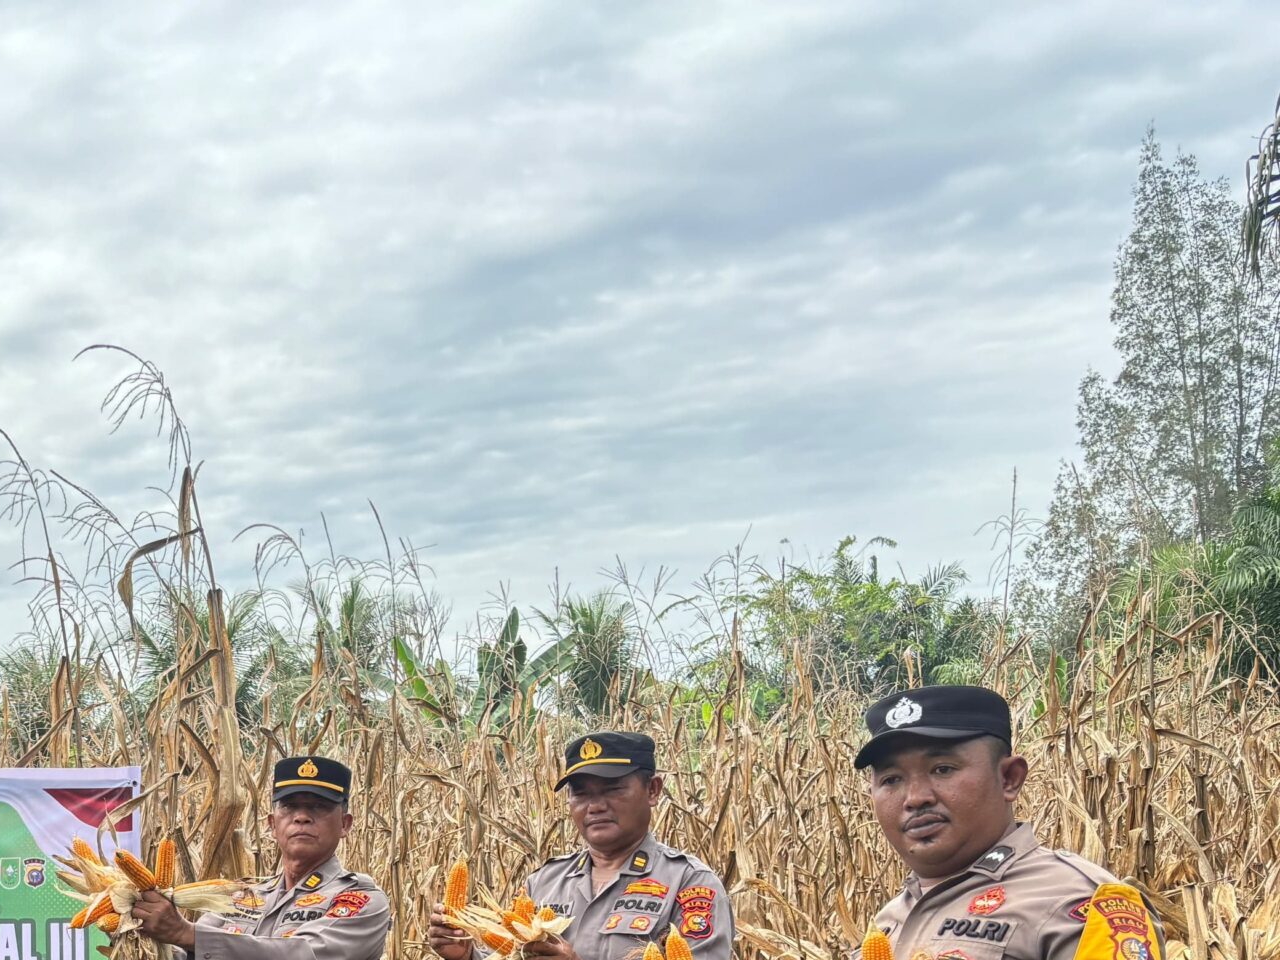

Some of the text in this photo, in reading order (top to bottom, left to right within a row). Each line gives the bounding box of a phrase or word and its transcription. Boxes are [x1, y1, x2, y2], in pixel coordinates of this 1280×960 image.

[614, 899, 662, 913] POLRI
[938, 918, 1010, 942] POLRI
[1113, 918, 1144, 930] RIAU
